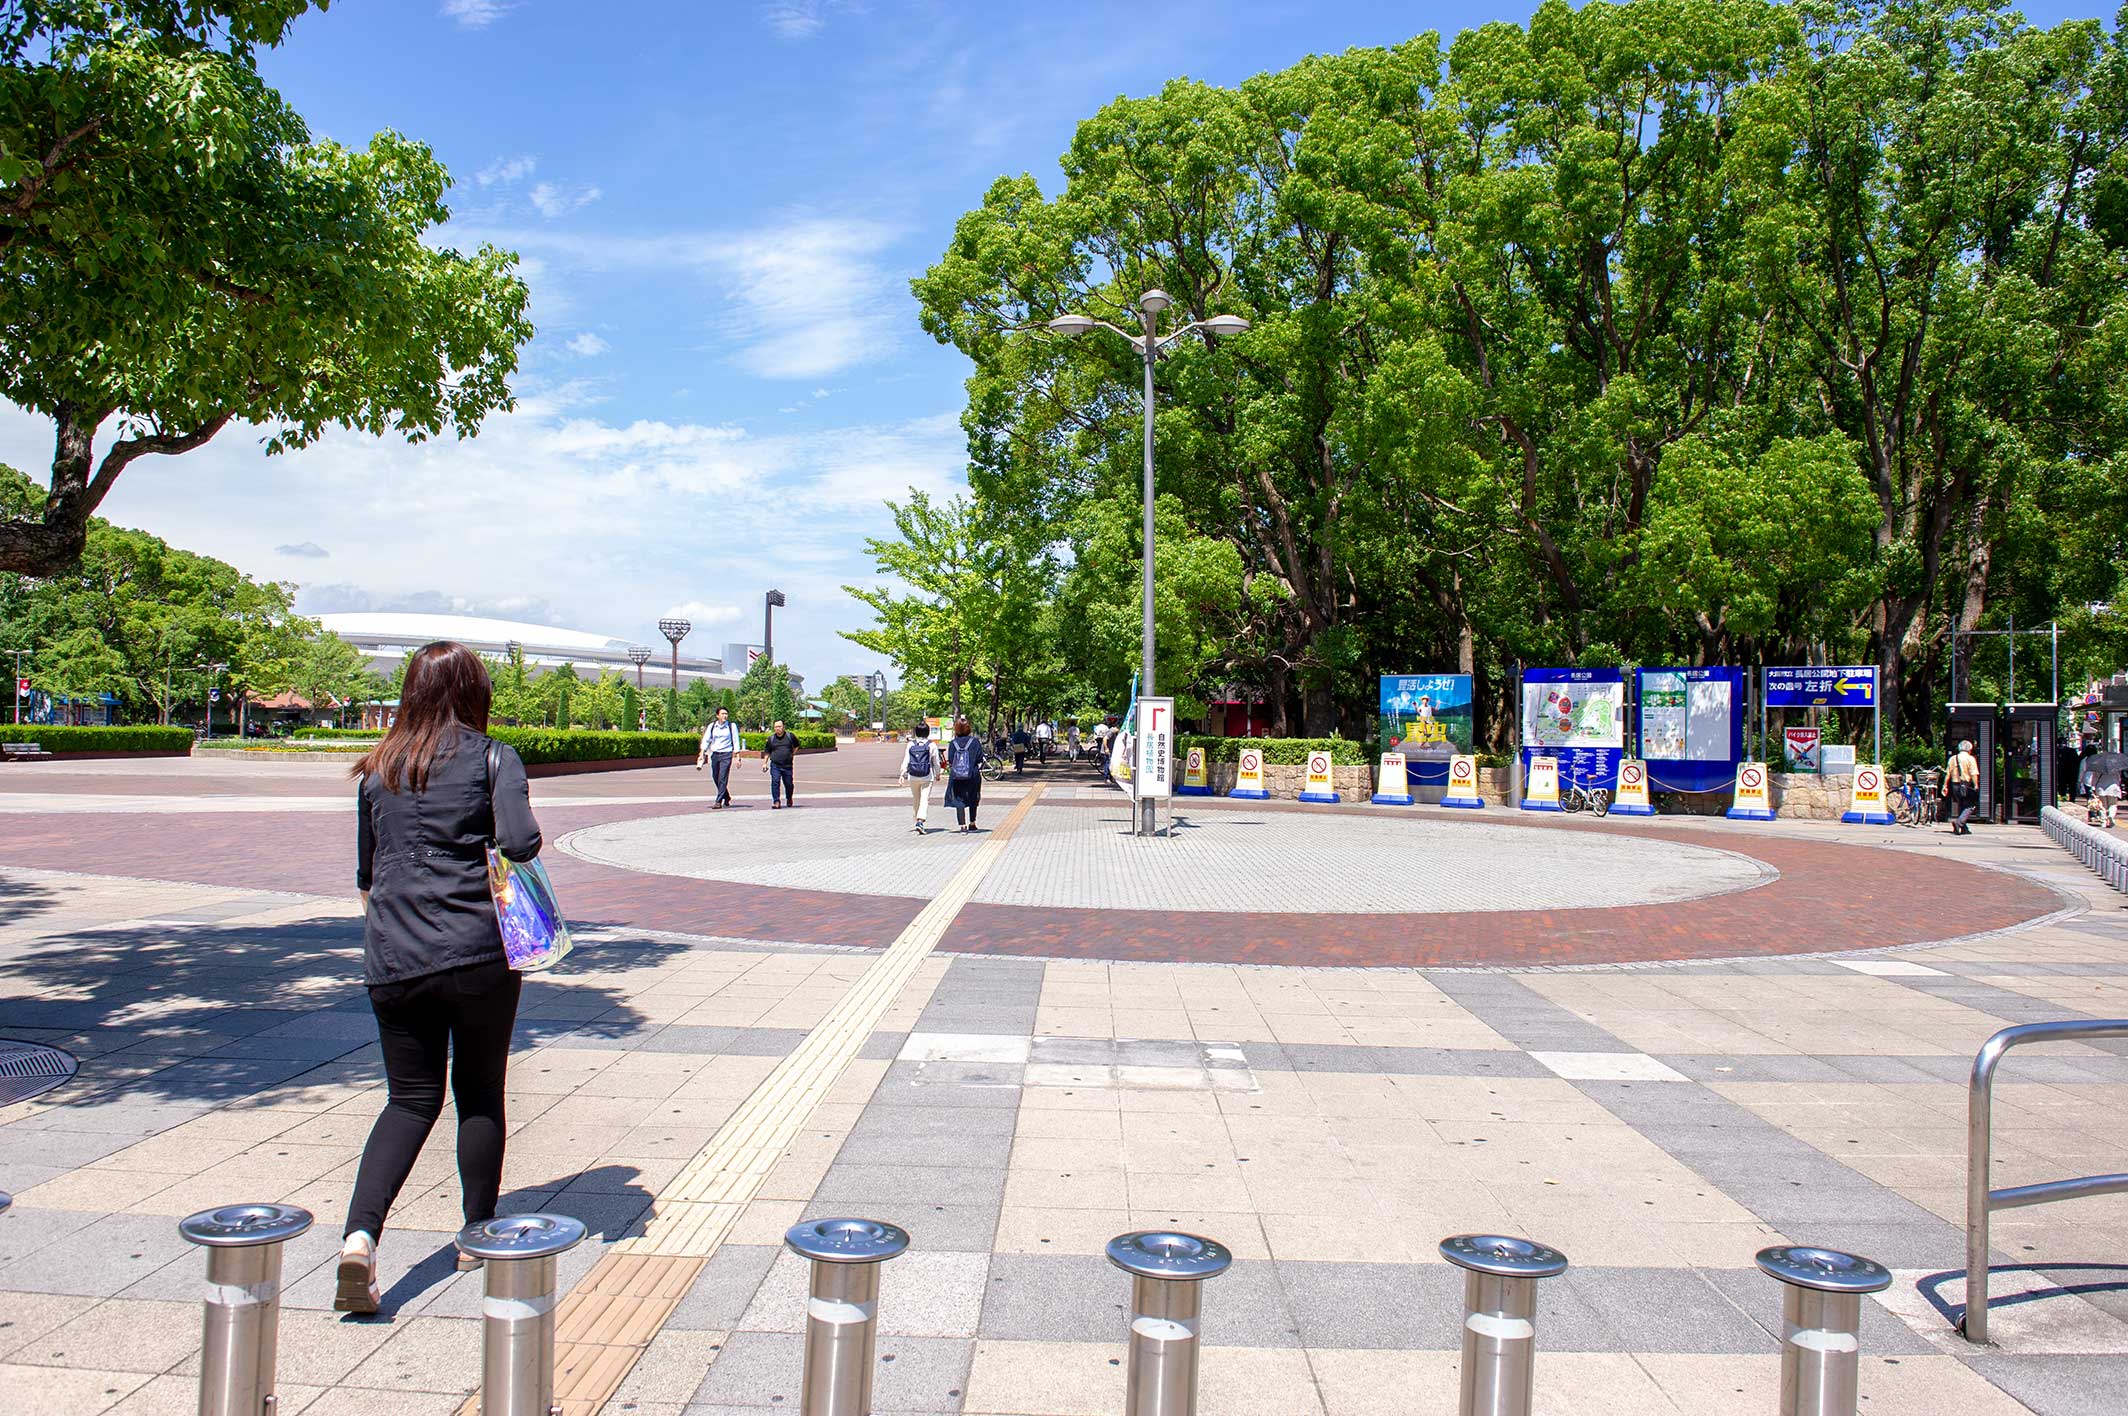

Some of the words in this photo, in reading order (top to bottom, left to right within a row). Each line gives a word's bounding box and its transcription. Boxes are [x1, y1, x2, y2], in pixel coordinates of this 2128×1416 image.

[1804, 680, 1833, 693] 左折
[1156, 732, 1166, 783] 自然史博物館
